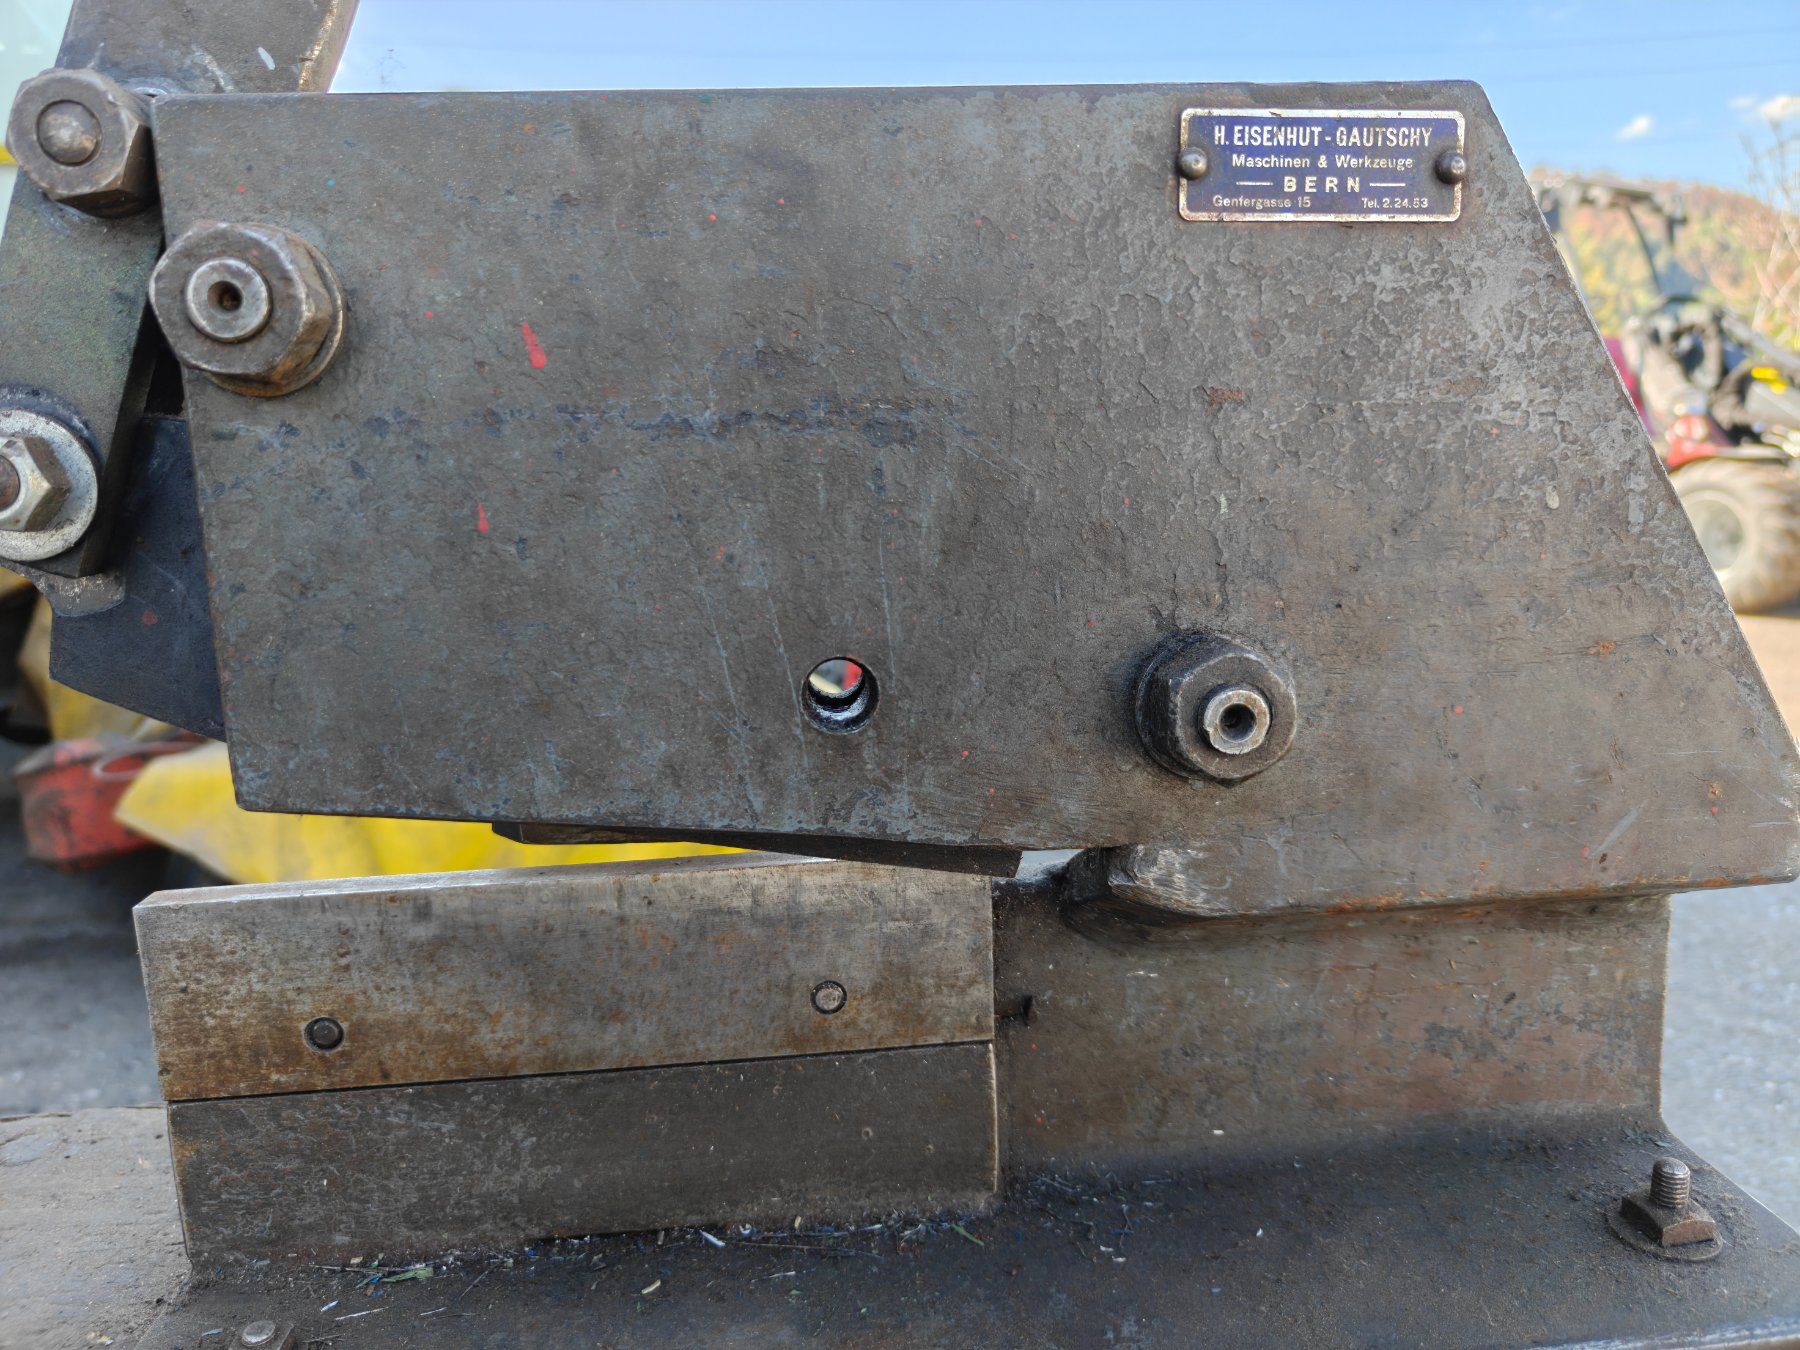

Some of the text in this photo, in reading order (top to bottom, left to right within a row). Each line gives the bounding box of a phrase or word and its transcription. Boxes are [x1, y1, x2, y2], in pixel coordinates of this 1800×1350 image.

[1214, 125, 1229, 146] H.
[1232, 153, 1414, 171] Maschinen & Werkzeuge
[1283, 176, 1360, 193] BERN
[1212, 194, 1292, 210] Genfergasse
[1297, 196, 1311, 208] 15
[1361, 197, 1380, 209] Tel.
